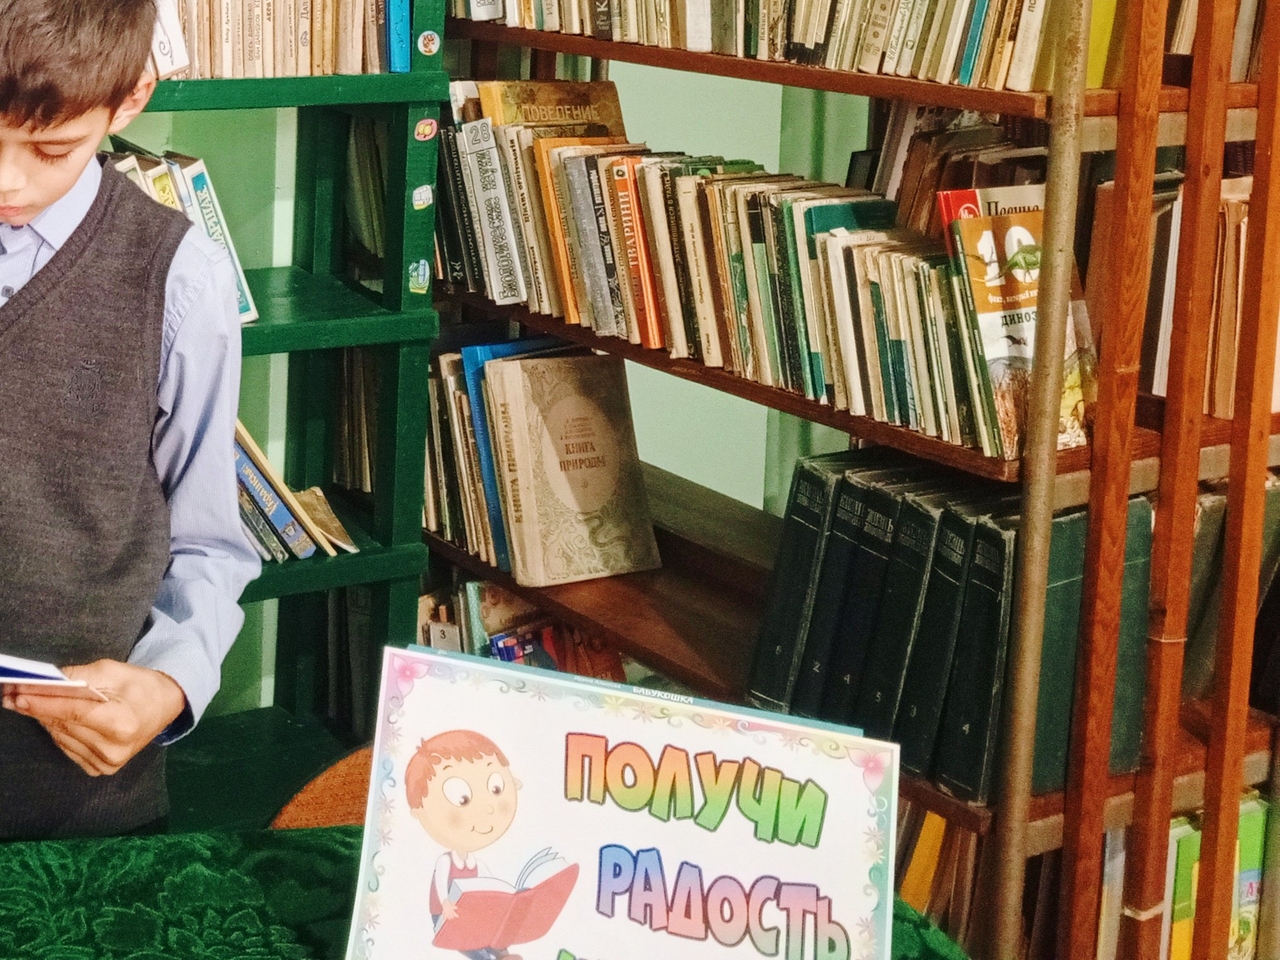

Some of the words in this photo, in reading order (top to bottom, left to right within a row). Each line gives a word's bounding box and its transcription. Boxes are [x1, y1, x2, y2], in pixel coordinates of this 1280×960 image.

[520, 104, 599, 121] ПОВЕДЕНИЕ
[470, 122, 490, 146] 28
[475, 150, 500, 191] науки
[616, 189, 640, 269] ТВАРИНИ
[482, 195, 518, 300] Биологические
[560, 455, 606, 472] ПРИРОДЫ
[564, 441, 596, 455] КНИГА
[508, 477, 525, 523] КНИГА
[440, 629, 446, 639] 3
[632, 685, 694, 705] БАБУКОШКА
[564, 731, 829, 848] ПОЛУЧИ
[595, 843, 851, 960] РАДОСТЬ
